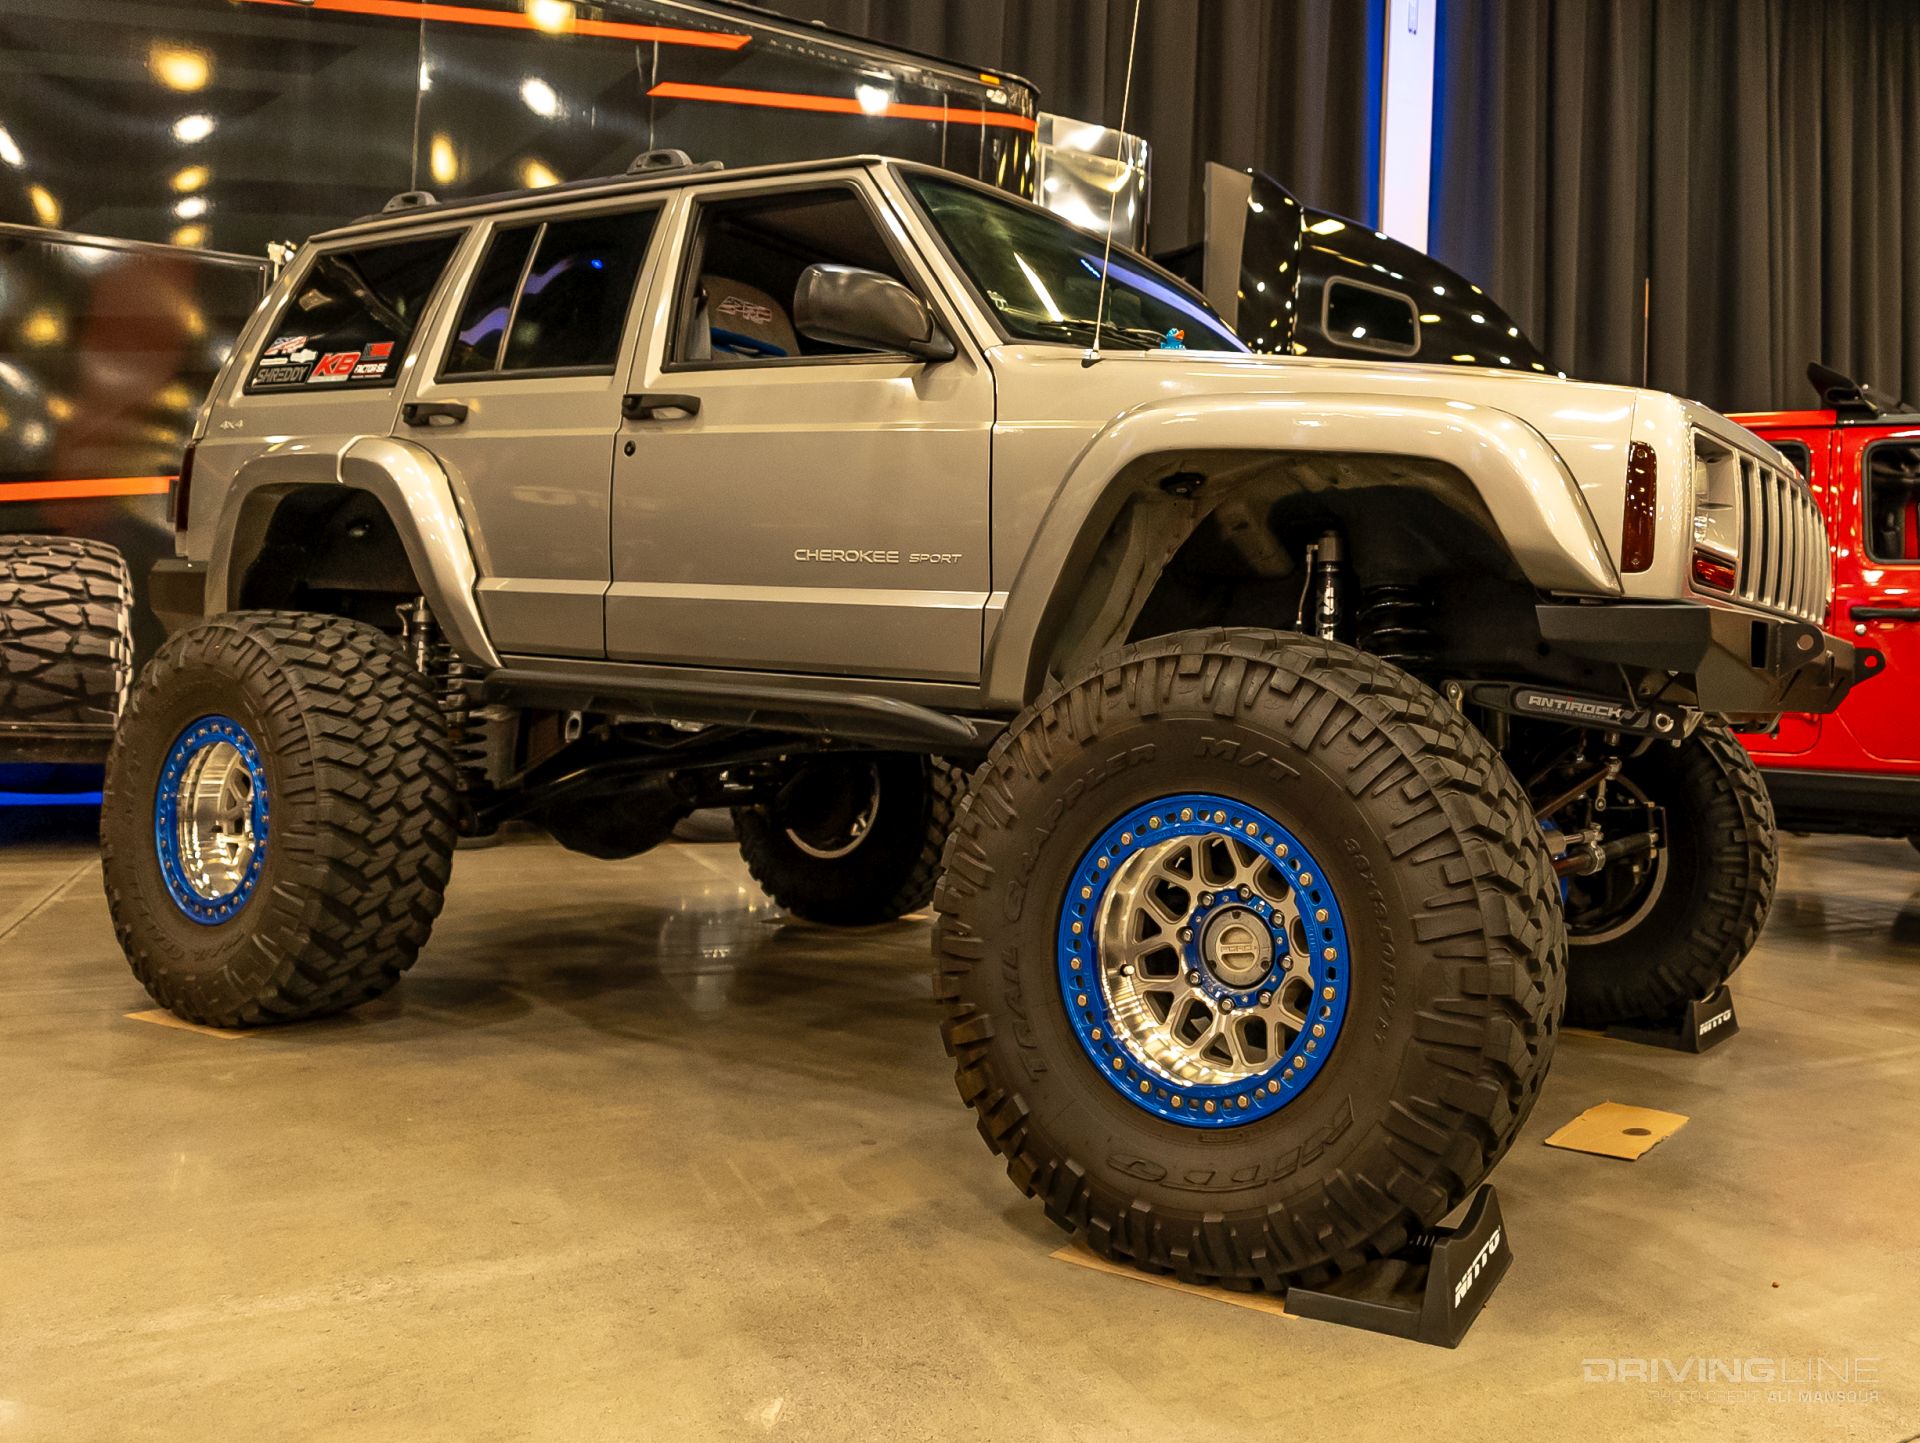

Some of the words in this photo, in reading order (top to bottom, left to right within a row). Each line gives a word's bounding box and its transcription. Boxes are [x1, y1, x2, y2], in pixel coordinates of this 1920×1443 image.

[257, 366, 308, 384] SHREDDY
[311, 352, 361, 377] KB
[794, 549, 899, 563] CHEROKEE
[909, 553, 962, 563] SPORT
[1528, 695, 1622, 718] ANTIROCK
[1003, 943, 1047, 1082] TRAIL
[1197, 735, 1301, 783] M/T
[1699, 1009, 1732, 1036] NITTO
[1455, 1225, 1500, 1308] NITTO
